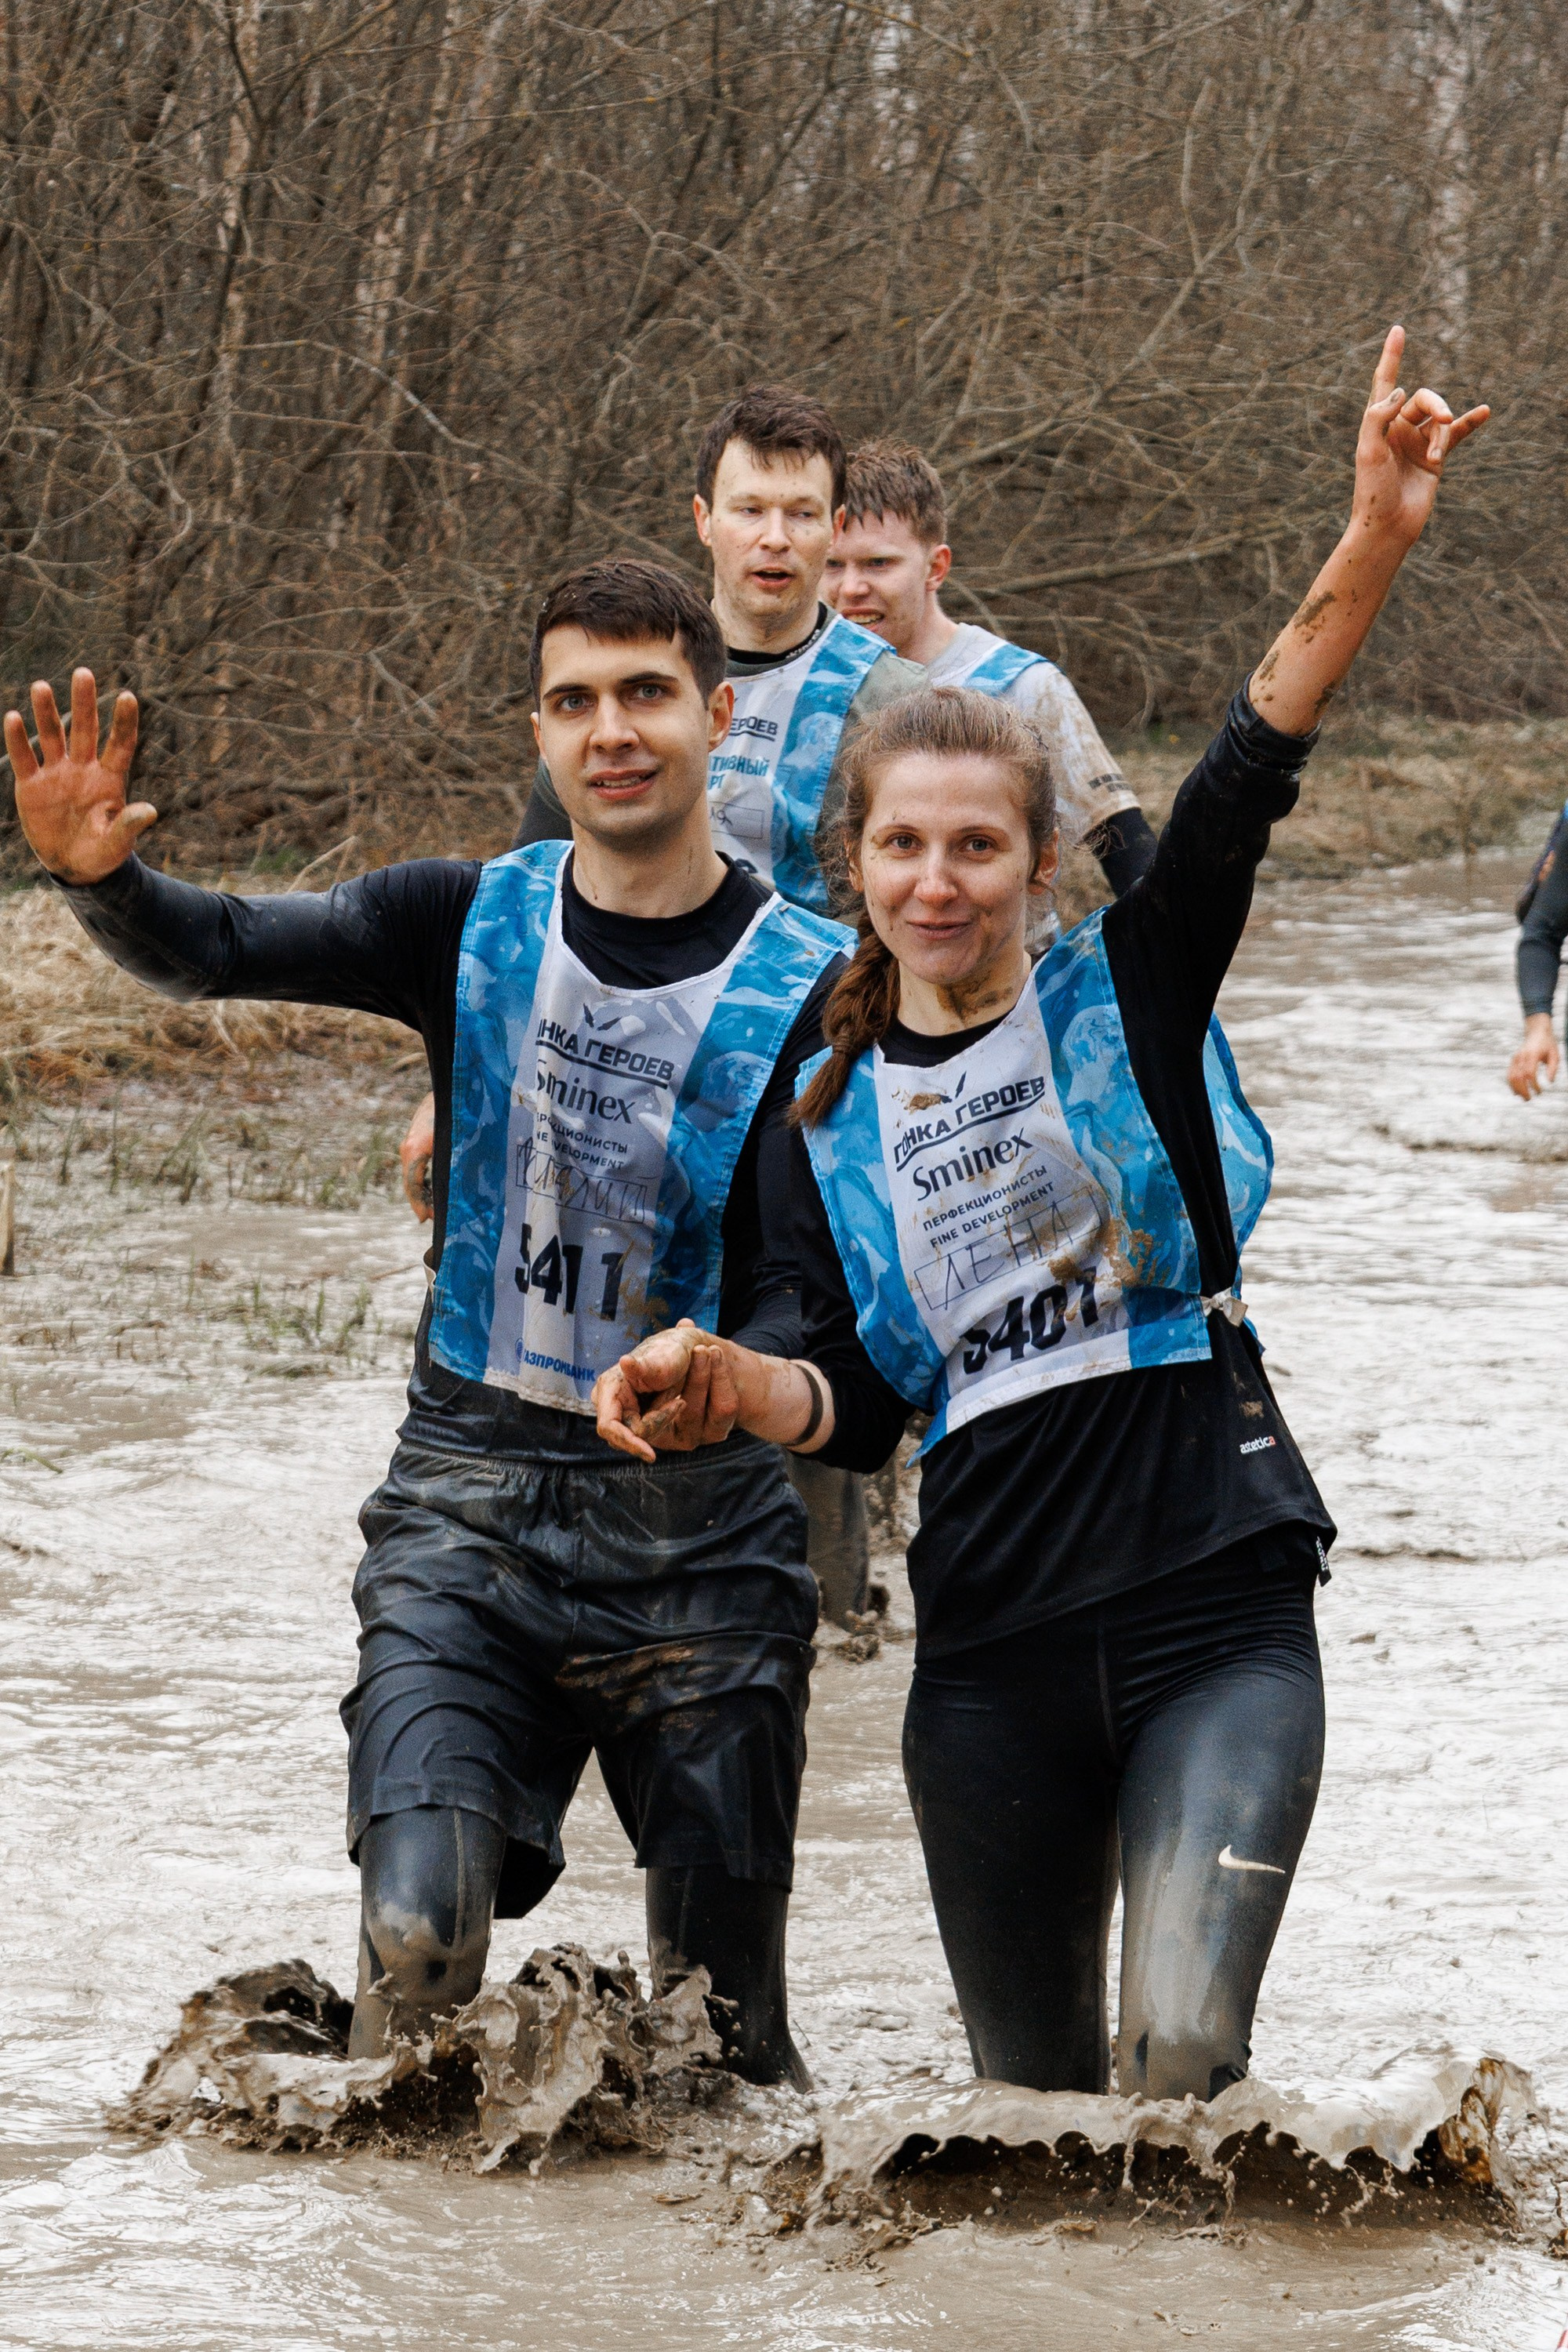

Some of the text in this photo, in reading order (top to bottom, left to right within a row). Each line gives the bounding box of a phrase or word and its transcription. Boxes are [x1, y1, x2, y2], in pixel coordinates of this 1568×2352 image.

[730, 716, 779, 735] ЕРОЕВ
[710, 755, 770, 777] ТИВНЫЙ
[538, 1018, 675, 1081] НКА ГЕРОЕВ
[893, 1076, 1045, 1164] ГОНКА ГЕРОЕВ
[551, 1139, 625, 1171] VELOPMENT
[913, 1127, 1033, 1202] Sminex
[922, 1164, 1047, 1232] ПЕРФЕКЦИОНИСТЫ
[930, 1181, 1055, 1248] FINE DEVELOPMENT
[515, 1223, 625, 1322] 5411
[944, 1200, 1074, 1311] ЛЕНА
[524, 1348, 596, 1382] АЗПРОМБАНК
